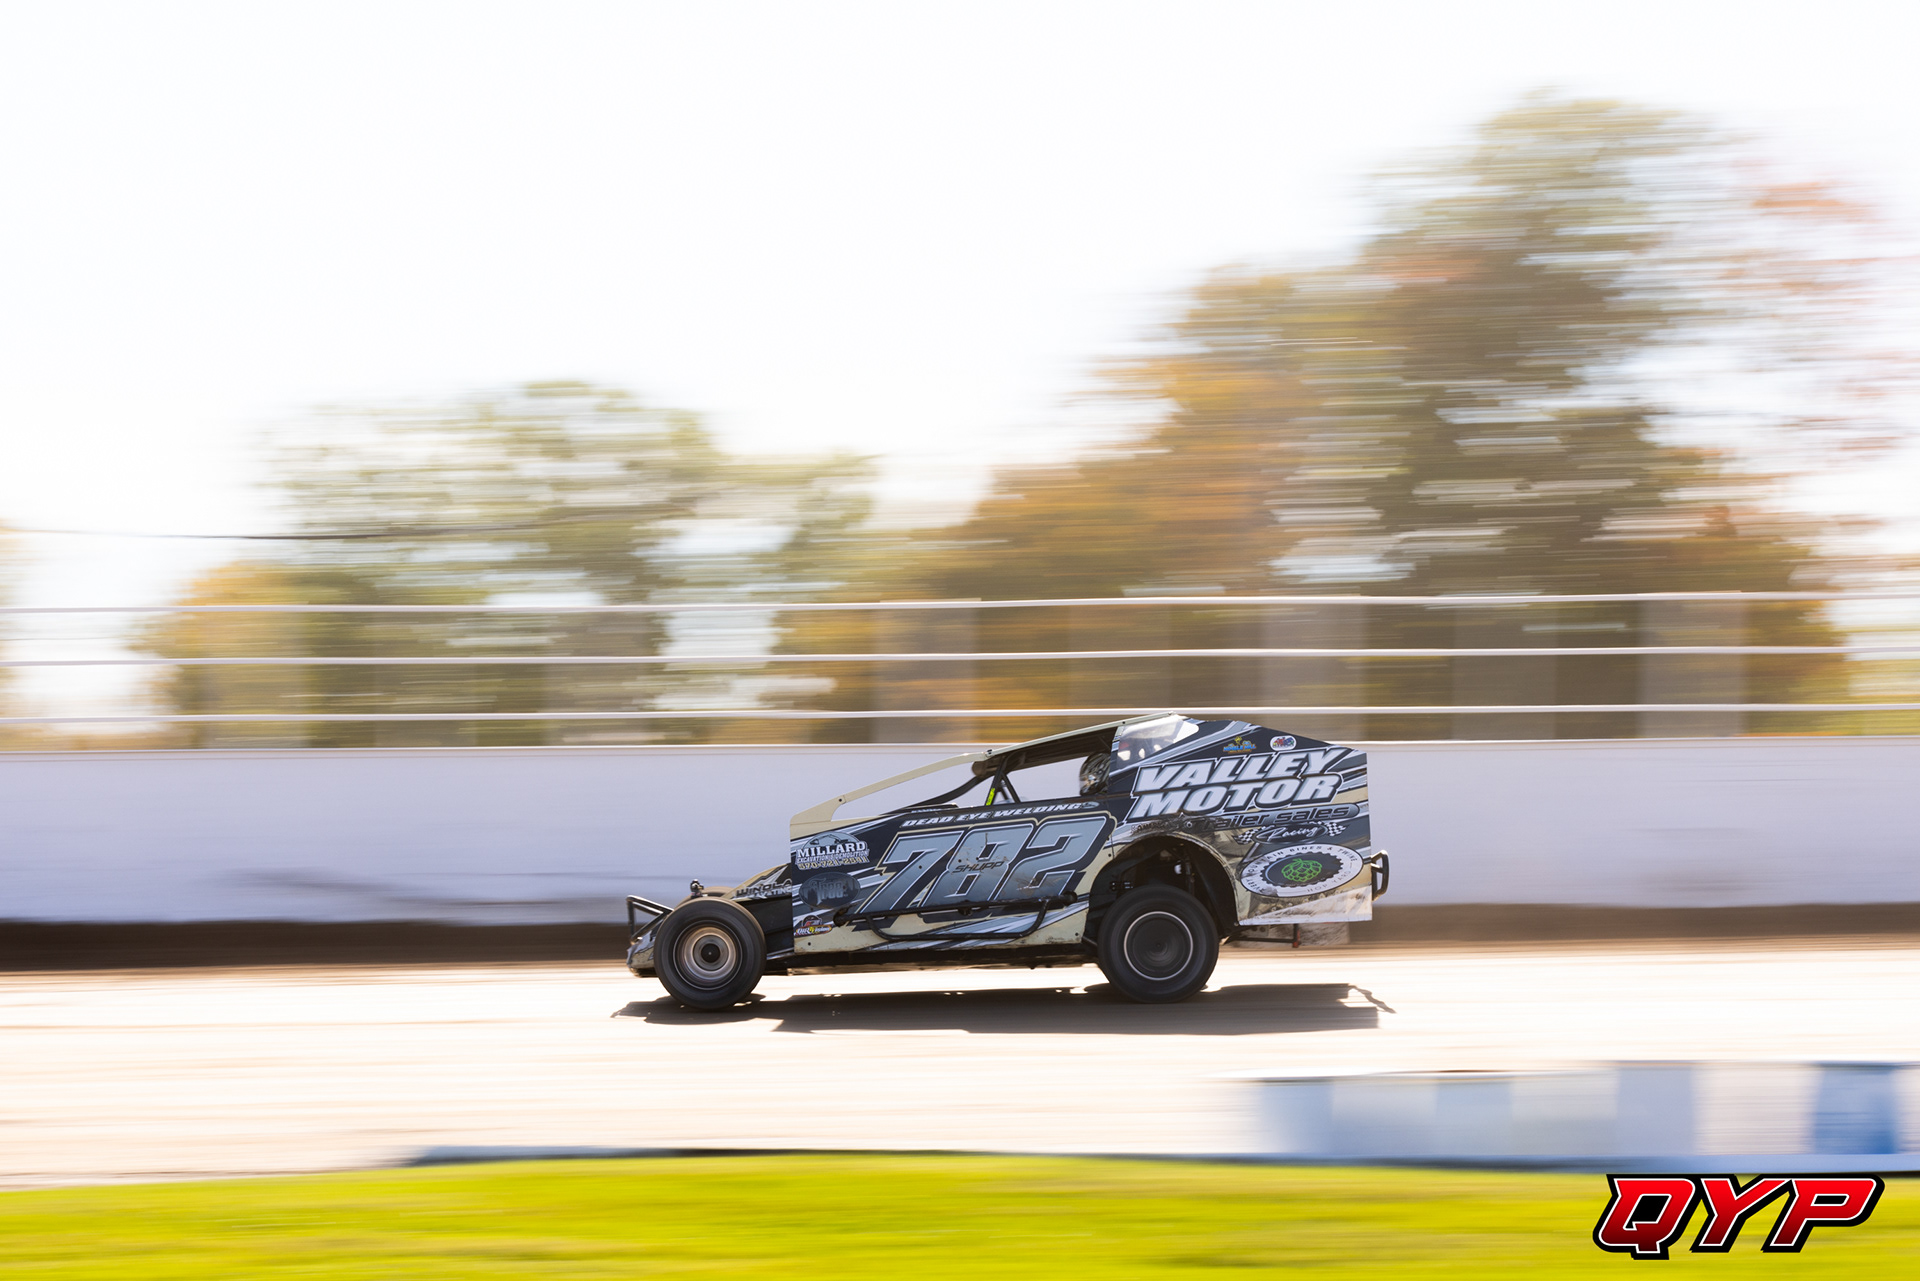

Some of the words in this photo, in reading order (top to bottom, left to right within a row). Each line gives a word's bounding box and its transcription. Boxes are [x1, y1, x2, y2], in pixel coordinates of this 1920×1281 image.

[1133, 749, 1340, 793] VALLEY
[1125, 773, 1342, 821] MOTOR
[901, 815, 955, 827] DEAD
[956, 810, 992, 821] EYE
[994, 802, 1082, 818] WELDING
[1274, 806, 1350, 824] sales
[1256, 825, 1319, 842] Racing
[797, 841, 866, 858] MILLARD
[859, 815, 1110, 913] 782
[952, 860, 1005, 873] SHUPP
[1246, 851, 1284, 876] OUNTAIN
